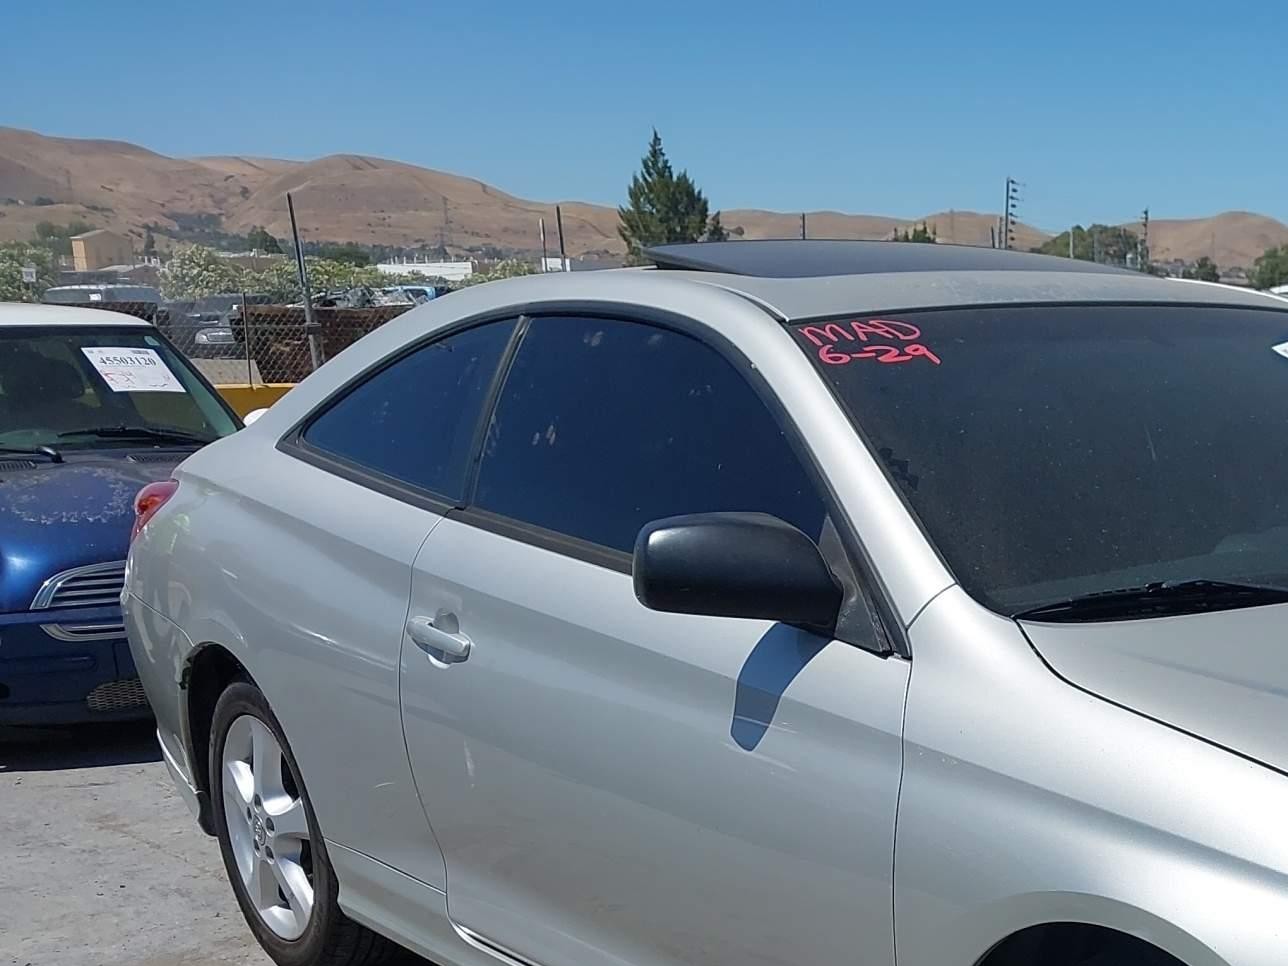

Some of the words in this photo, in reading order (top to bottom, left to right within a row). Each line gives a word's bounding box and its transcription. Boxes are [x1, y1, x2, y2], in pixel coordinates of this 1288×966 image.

[799, 320, 921, 346] MAD
[98, 356, 157, 366] 45503120
[819, 344, 941, 365] 6-29
